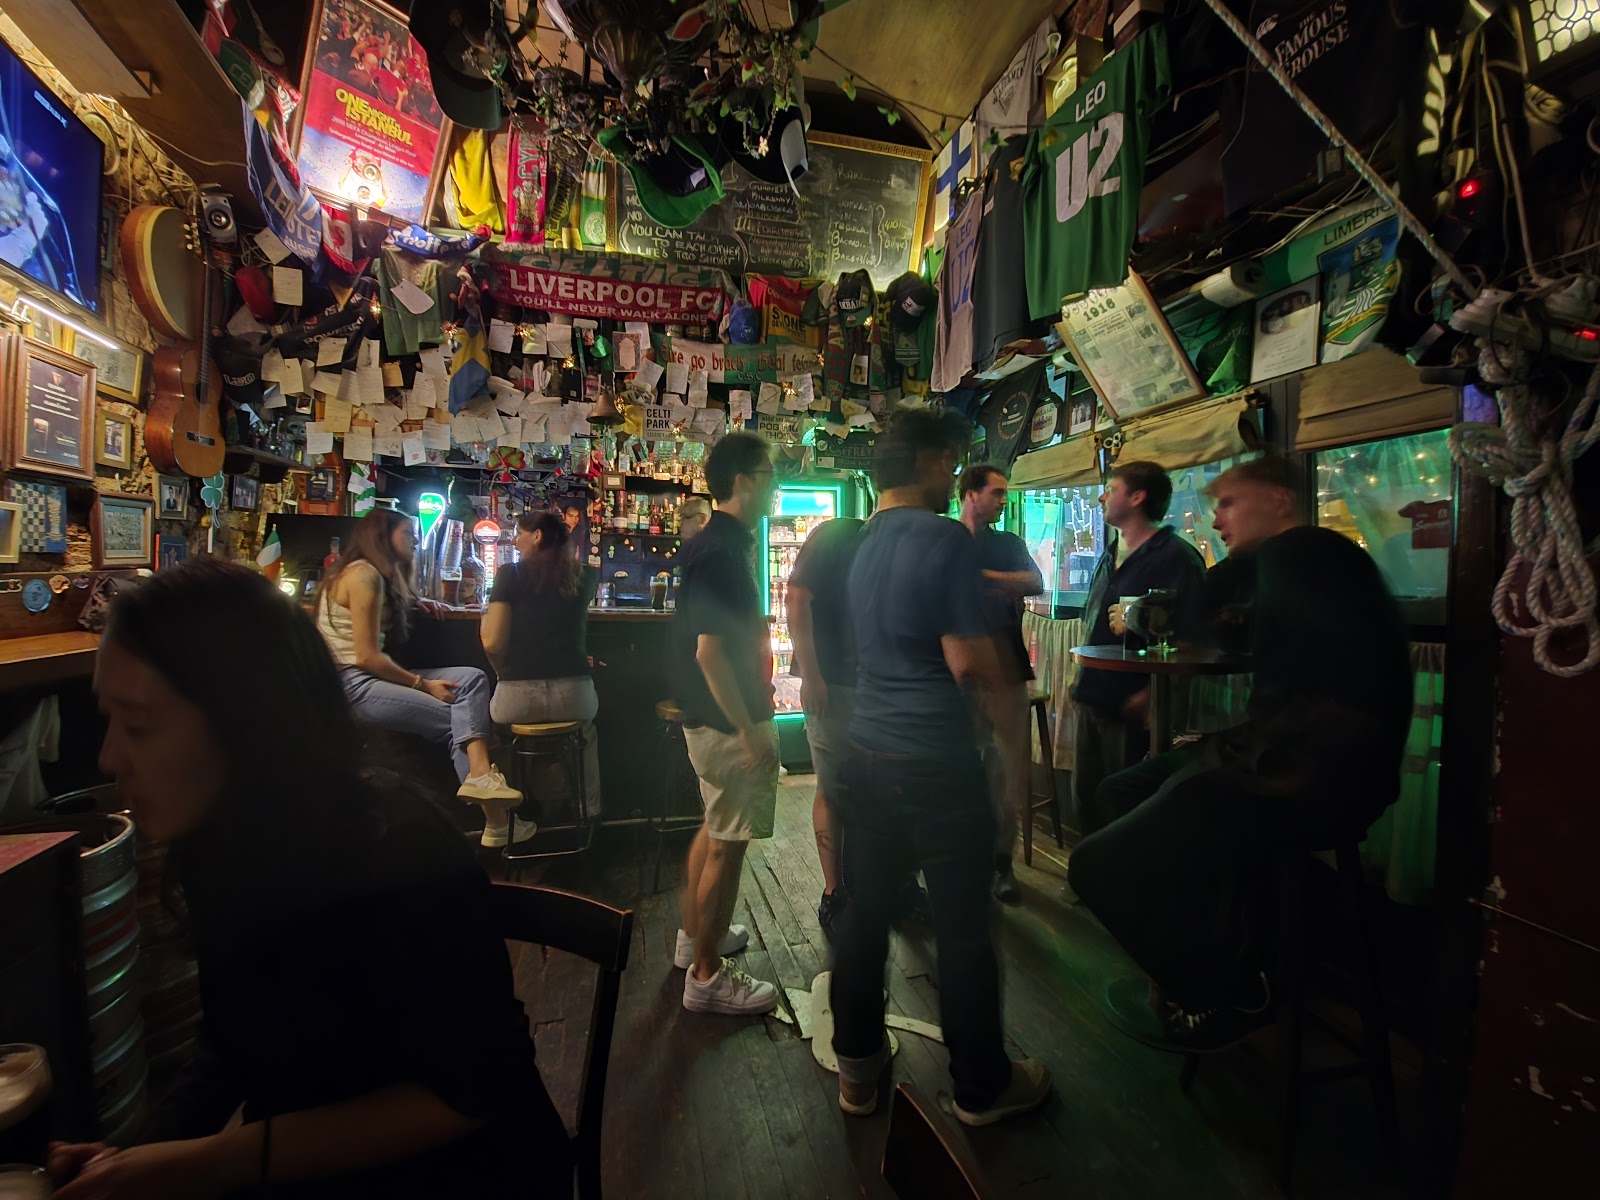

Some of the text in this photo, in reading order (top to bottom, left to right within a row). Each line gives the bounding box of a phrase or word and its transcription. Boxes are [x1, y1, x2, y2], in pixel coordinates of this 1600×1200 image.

[1275, 0, 1347, 67] FAMOUS
[335, 88, 369, 114] ONE
[1076, 80, 1106, 123] LEO
[345, 103, 414, 146] ISTANBUL
[1056, 112, 1123, 223] U2
[630, 223, 653, 236] YOU
[655, 227, 683, 240] CAN
[956, 219, 972, 249] LEO
[1324, 202, 1397, 246] LIMERIC
[637, 246, 669, 259] LIFE'S
[674, 250, 696, 261] TOO
[651, 237, 741, 261] TO EACH OTHER
[509, 268, 713, 311] LIVERPOOL FC
[513, 293, 708, 323] YOU'LL NEVER WALK ALONE
[1083, 298, 1116, 322] 1916
[691, 355, 706, 372] go
[646, 418, 670, 430] PARK
